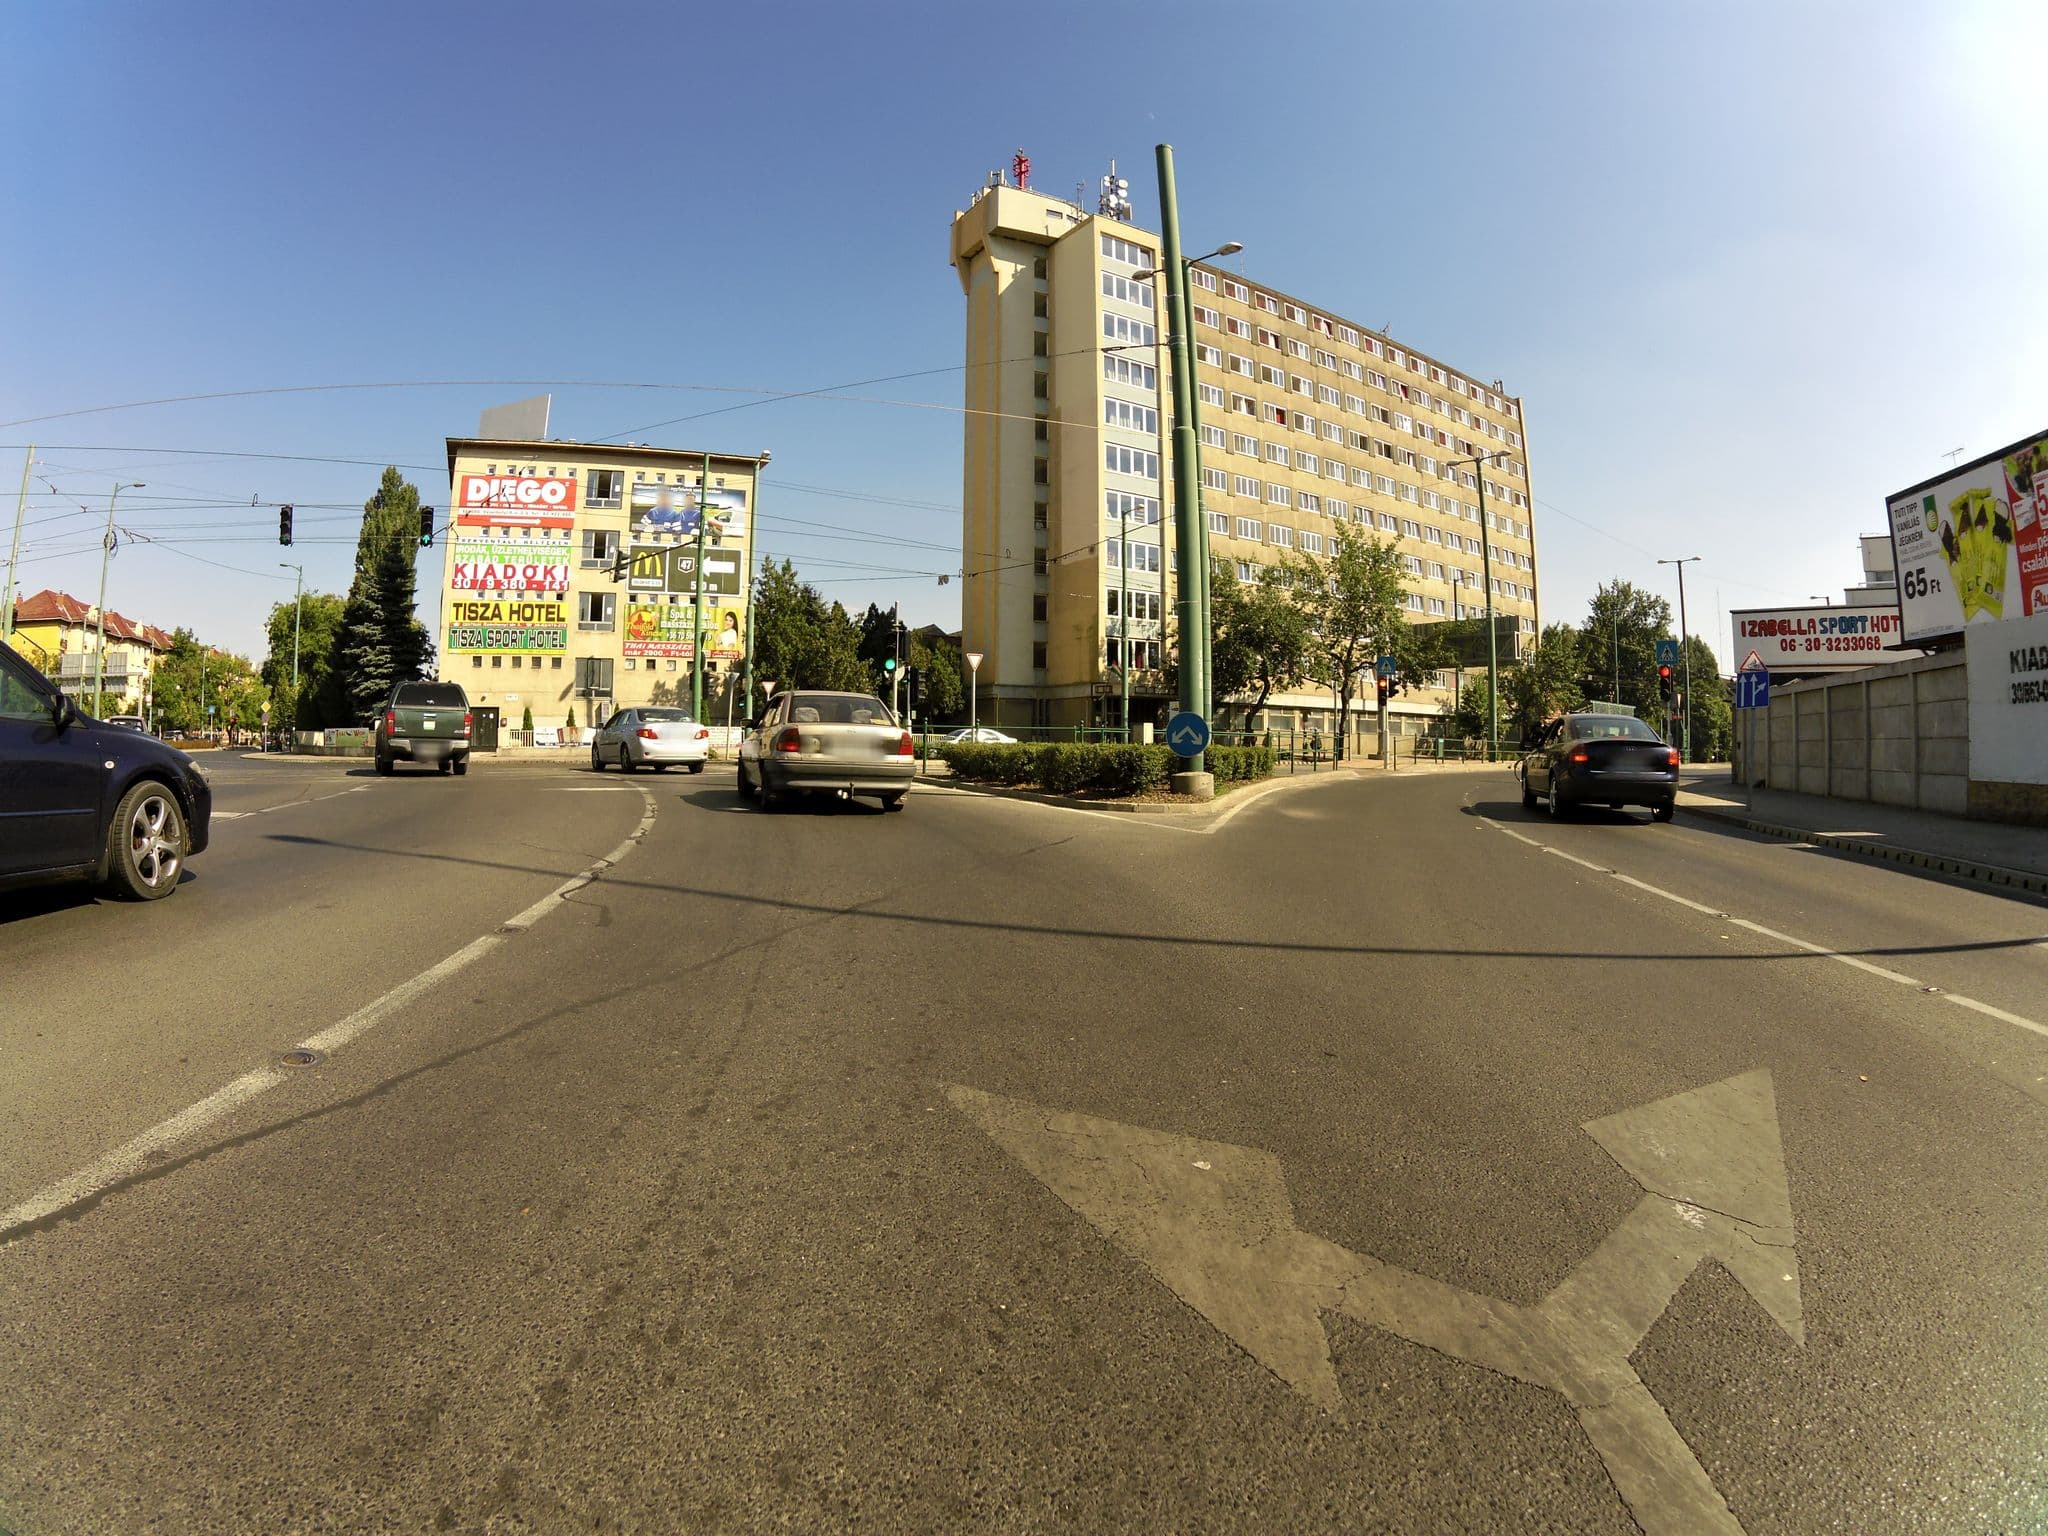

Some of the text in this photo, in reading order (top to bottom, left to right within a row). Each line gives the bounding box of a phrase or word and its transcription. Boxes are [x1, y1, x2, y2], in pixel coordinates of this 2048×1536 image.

[467, 478, 567, 504] DIEGO
[1894, 502, 1918, 519] TUTI TIPP
[1896, 515, 1920, 533] VANÍLIÁS
[1898, 530, 1923, 547] JÉGKRÉM
[680, 560, 693, 570] 47
[1904, 567, 1941, 599] 65 Ft
[452, 602, 566, 622] TISZA HOTEL
[670, 609, 685, 619] Spa
[1740, 618, 1817, 638] IZABELLA
[1818, 616, 1868, 635] SPORT
[451, 629, 566, 648] TISZA SPORT HOTEL
